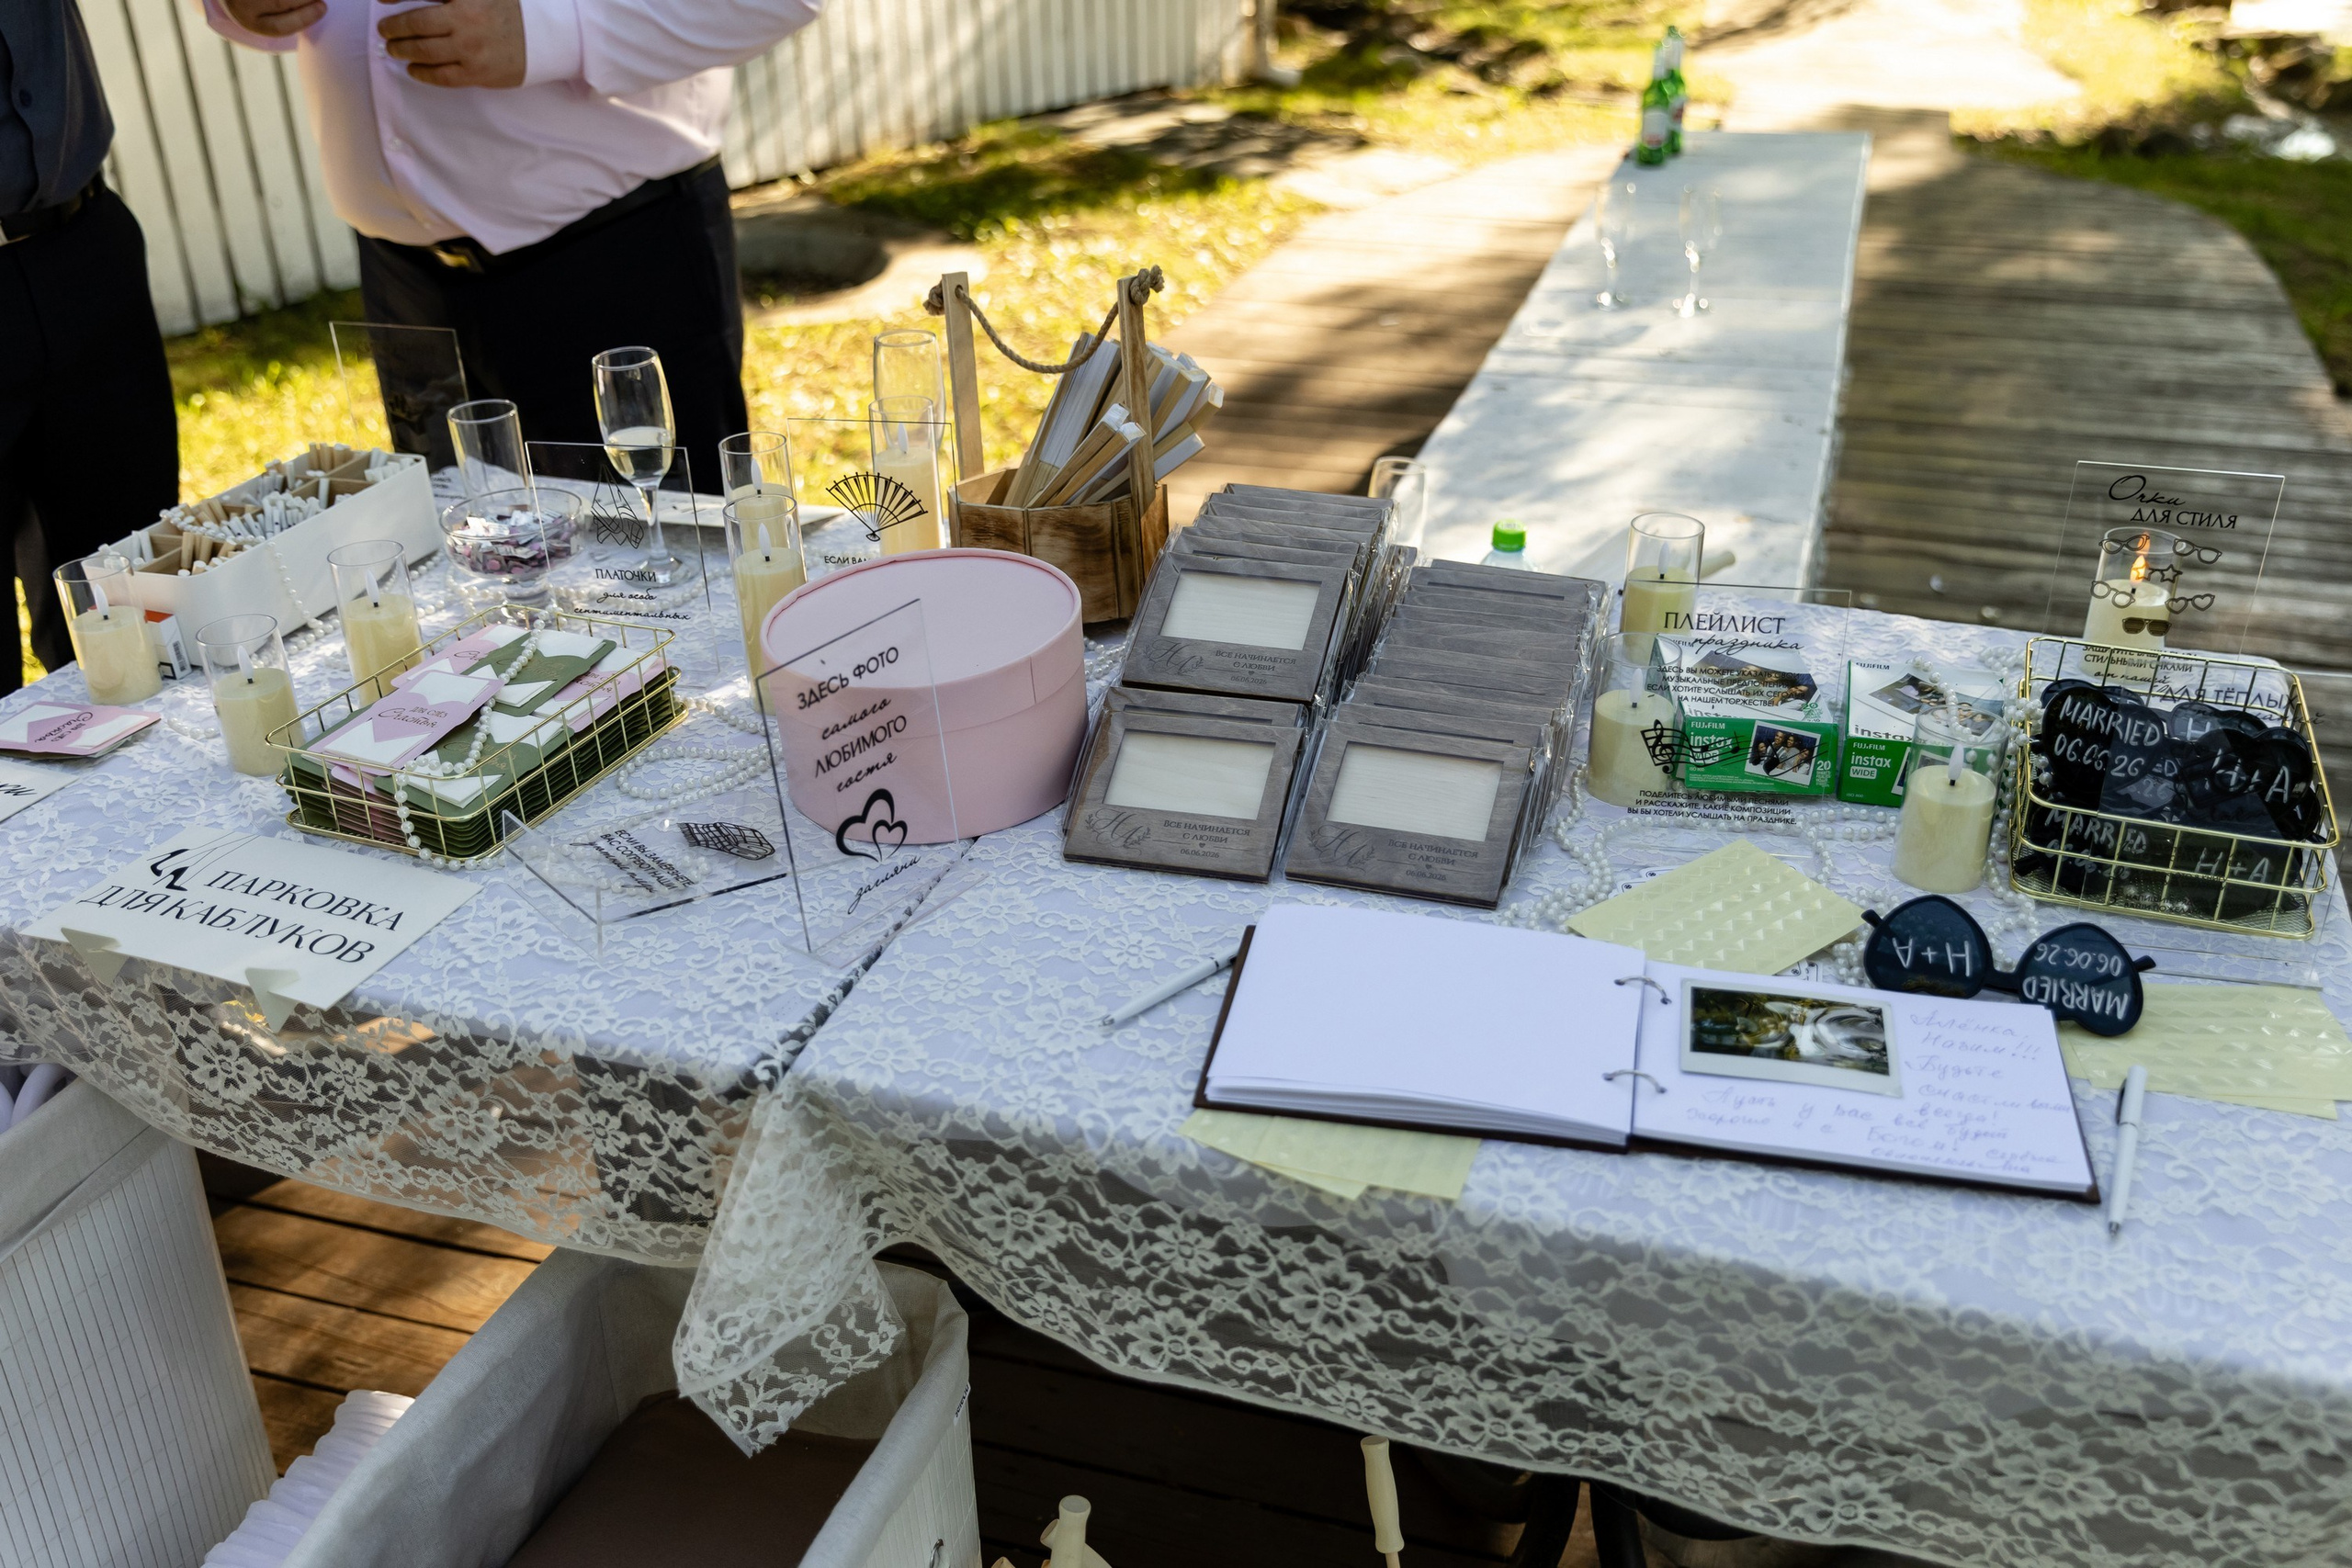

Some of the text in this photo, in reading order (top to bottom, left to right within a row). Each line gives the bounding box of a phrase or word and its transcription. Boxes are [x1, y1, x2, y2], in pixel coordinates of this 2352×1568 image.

[2109, 475, 2186, 506] Очки
[2130, 508, 2238, 529] ДЛЯ СТИЛЯ
[824, 556, 871, 565] ЕСЛИ ВА
[595, 569, 657, 582] ПЛАТОЧКИ
[597, 588, 657, 604] для особо
[574, 607, 691, 621] сентиментальных
[1664, 612, 1785, 634] ПЛЕЙЛИСТ
[1693, 634, 1804, 656] праздника
[1234, 652, 1296, 665] НАЧИНАЕТСЯ
[1241, 662, 1276, 671] ЛЮБВИ
[797, 647, 899, 711] ЗДЕСЬ ФОТО
[1657, 665, 1683, 673] ЗДЕСЬ
[1700, 668, 1735, 676] МОЖЕТЕ
[1736, 669, 1771, 678] УКАЗАТЬ
[1230, 675, 1267, 685] 06.06.2026
[1662, 675, 1724, 685] МУЗЫКАЛЬНЫЕ
[1671, 685, 1702, 694] ХОТИТЕ
[1702, 687, 1751, 696] УСЛЫШАТЬ
[2160, 686, 2205, 704] ДЛЯ
[1690, 696, 1724, 705] НАШЕМ
[820, 696, 891, 740] самого
[1690, 721, 1725, 729] FUJIFILM
[2059, 694, 2160, 746] MARRIED
[814, 715, 908, 778] ЛЮБИМОГО
[1690, 732, 1733, 749] instax
[1853, 742, 1885, 750] FUJIFILM
[1817, 760, 1831, 771] 20
[1851, 752, 1891, 768] instax
[836, 751, 898, 793] гостя
[1851, 768, 1875, 777] WIDE
[1639, 790, 1789, 806] ПОДЕЛИТЕСЬ ЛЮБИМЫМИ ПЕСНЯМИ
[1653, 809, 1684, 818] ХОТЕЛИ
[1685, 811, 1732, 821] УСЛЫШАТЬ
[1747, 816, 1797, 825] ПРАЗДНИКЕ.
[1730, 805, 1791, 815] КОМПОЗИЦИИ
[1183, 823, 1250, 837] НАЧИНАЕТСЯ
[2044, 808, 2147, 854] MARRED
[615, 829, 640, 846] ЕСЛИ
[634, 843, 650, 854] ВЫ
[1192, 834, 1227, 843] ЛЮБВИ
[1180, 849, 1220, 858] 06.06.2026
[1409, 842, 1478, 858] НАЧИНАЕТСЯ
[600, 833, 678, 890] ВАС СОГРЕЮТ НАШИ
[1418, 855, 1455, 865] ЛЮБВИ
[1406, 870, 1446, 881] 06.06.2026
[847, 855, 921, 915] загляни
[203, 870, 405, 931] ПАРКОВКА
[77, 886, 376, 963] ДЛЯ КАБЛУКОВ
[2022, 976, 2129, 1020] MARRIED
